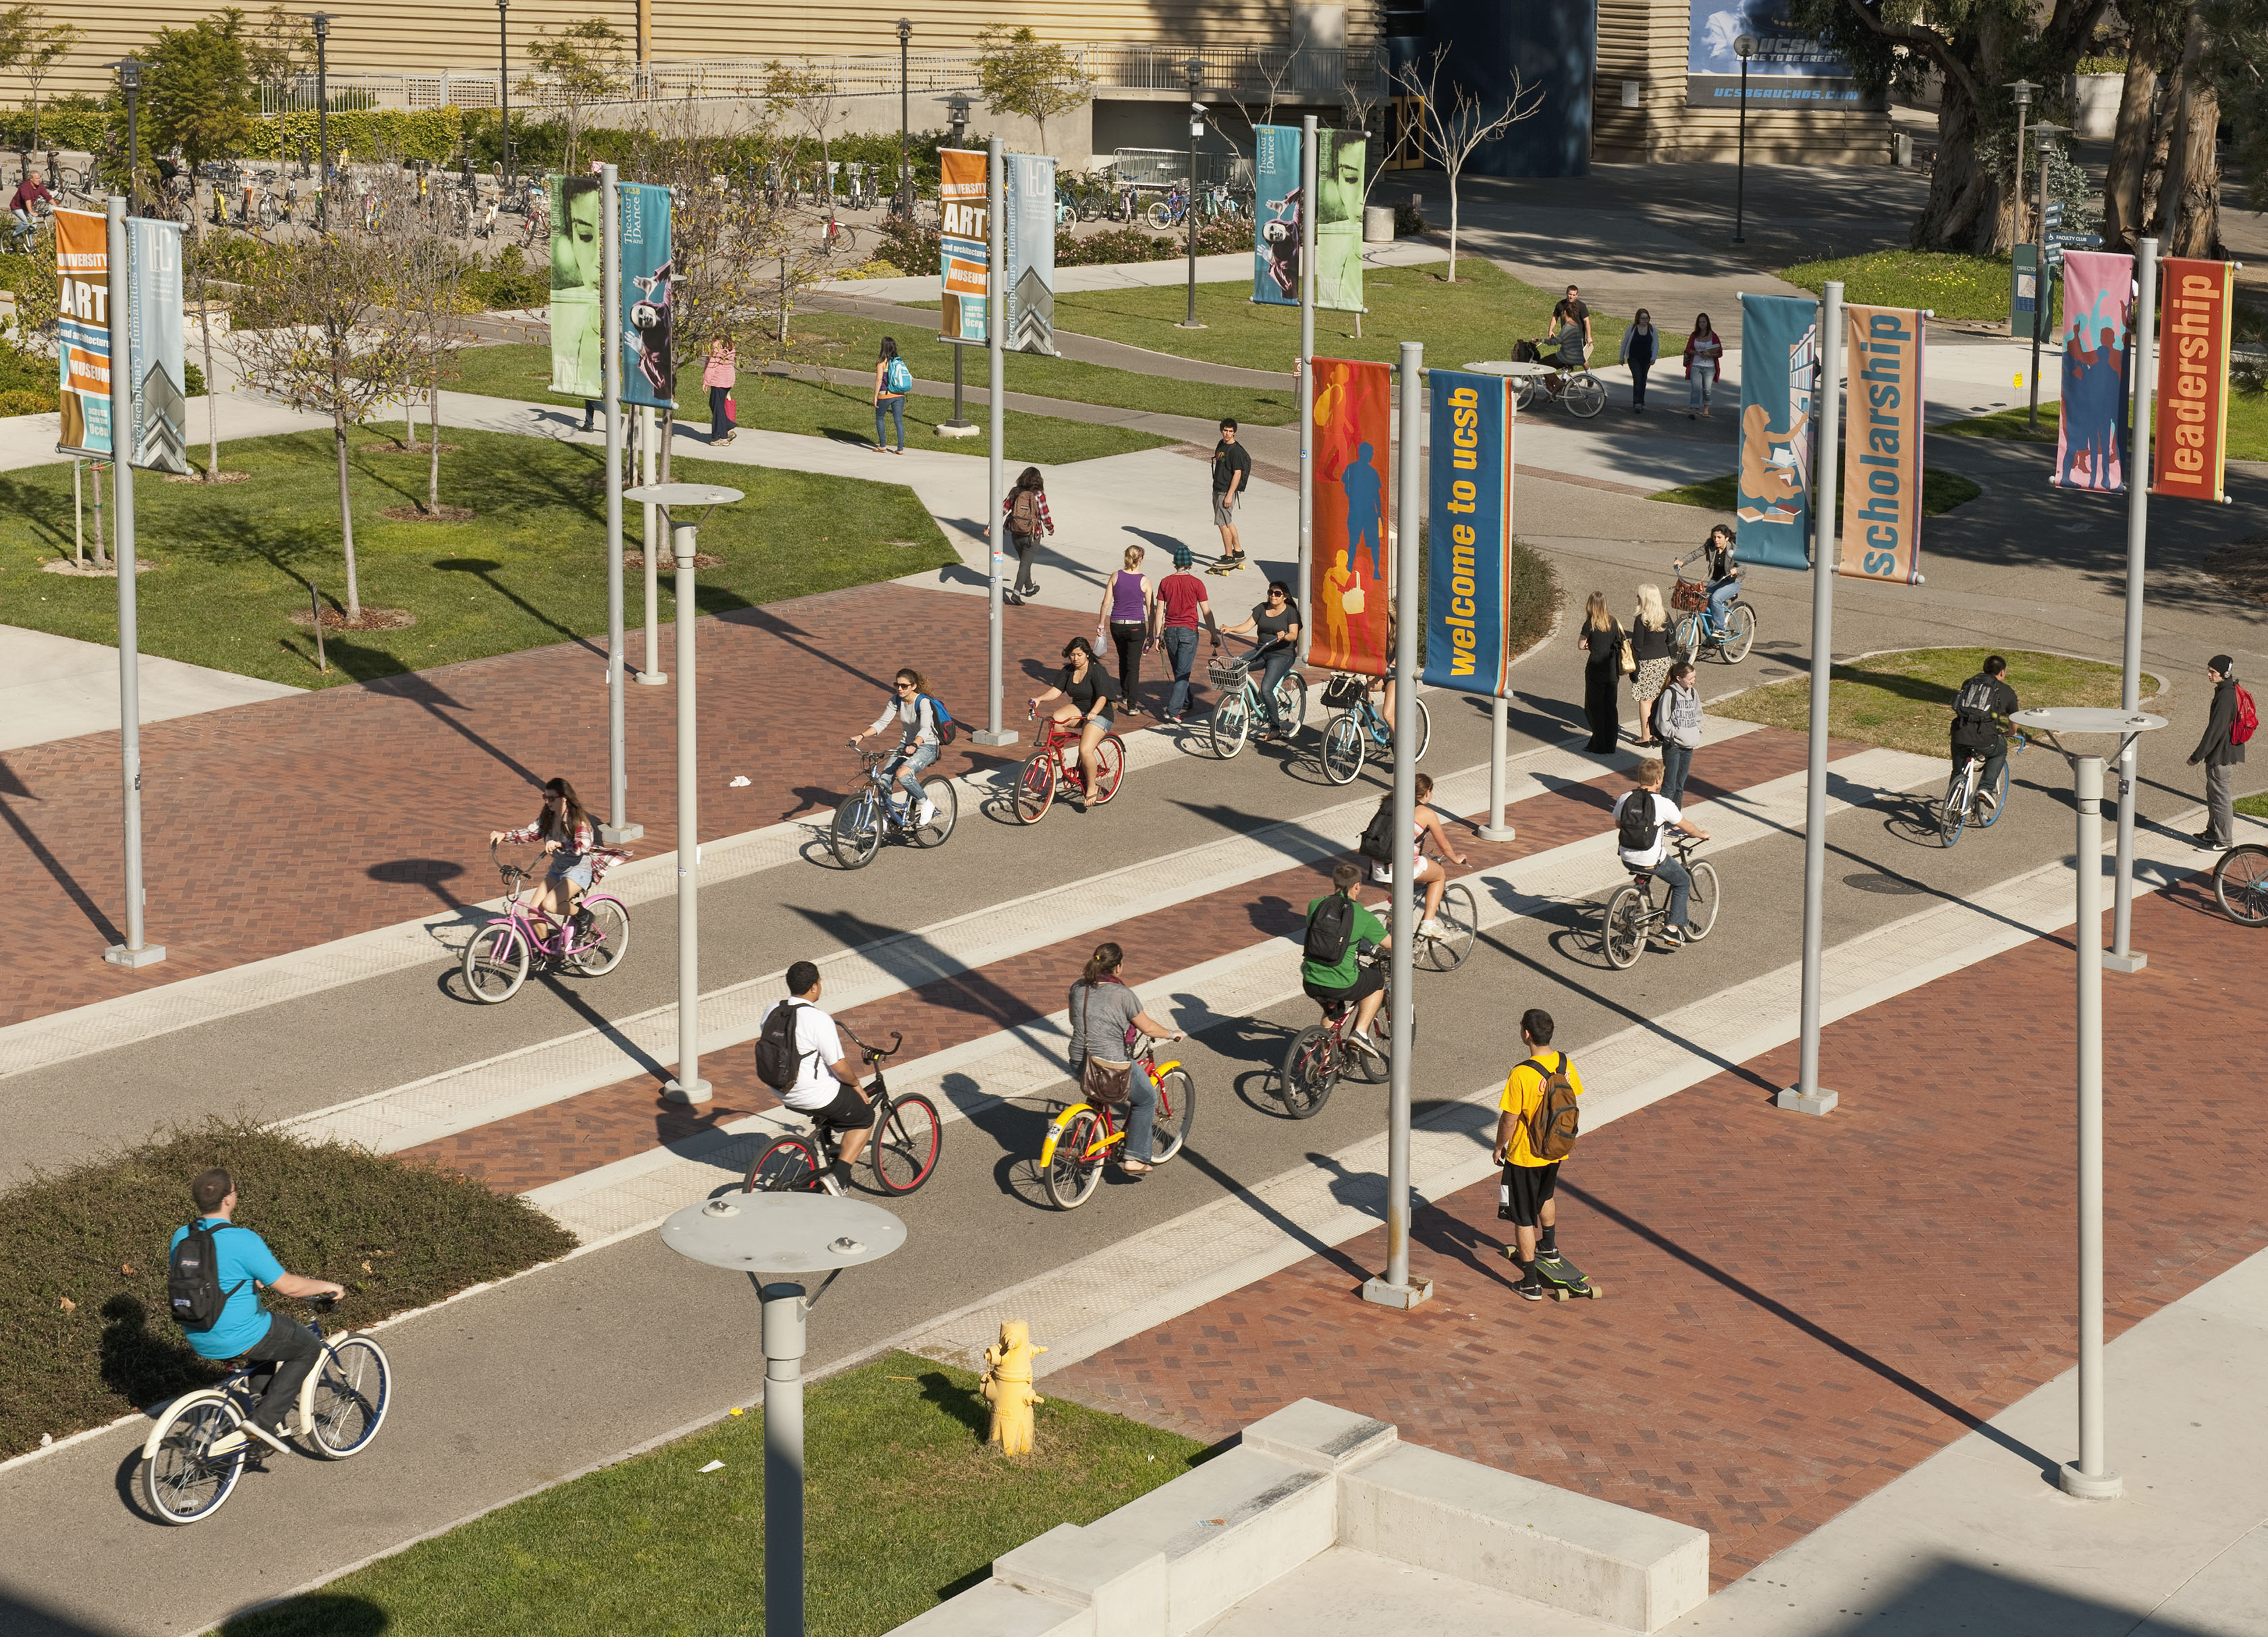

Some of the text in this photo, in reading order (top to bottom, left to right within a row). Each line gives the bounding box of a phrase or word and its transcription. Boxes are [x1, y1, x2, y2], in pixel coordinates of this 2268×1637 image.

[1736, 53, 1766, 61] DRE
[1785, 54, 1800, 62] BE
[1758, 38, 1820, 54] UCSB
[1259, 134, 1267, 175] Theater
[1266, 136, 1275, 169] Dance
[624, 187, 641, 195] UCSB
[942, 182, 987, 195] UNIVERSITY
[624, 194, 632, 244] Theater
[632, 196, 641, 238] Dance
[943, 203, 986, 238] ART
[1008, 196, 1016, 257] Humanities
[57, 253, 107, 267] UNIVERSITY
[942, 244, 987, 258] and architecture
[950, 267, 987, 286] MUSEUM
[60, 277, 108, 323] ART
[130, 272, 140, 350] Humanities
[60, 328, 111, 348] and architecture
[70, 359, 111, 383] MUSEUM
[2165, 274, 2220, 485] leadership
[1858, 314, 1912, 576] scholarship
[1445, 387, 1479, 676] welcome to ucsb
